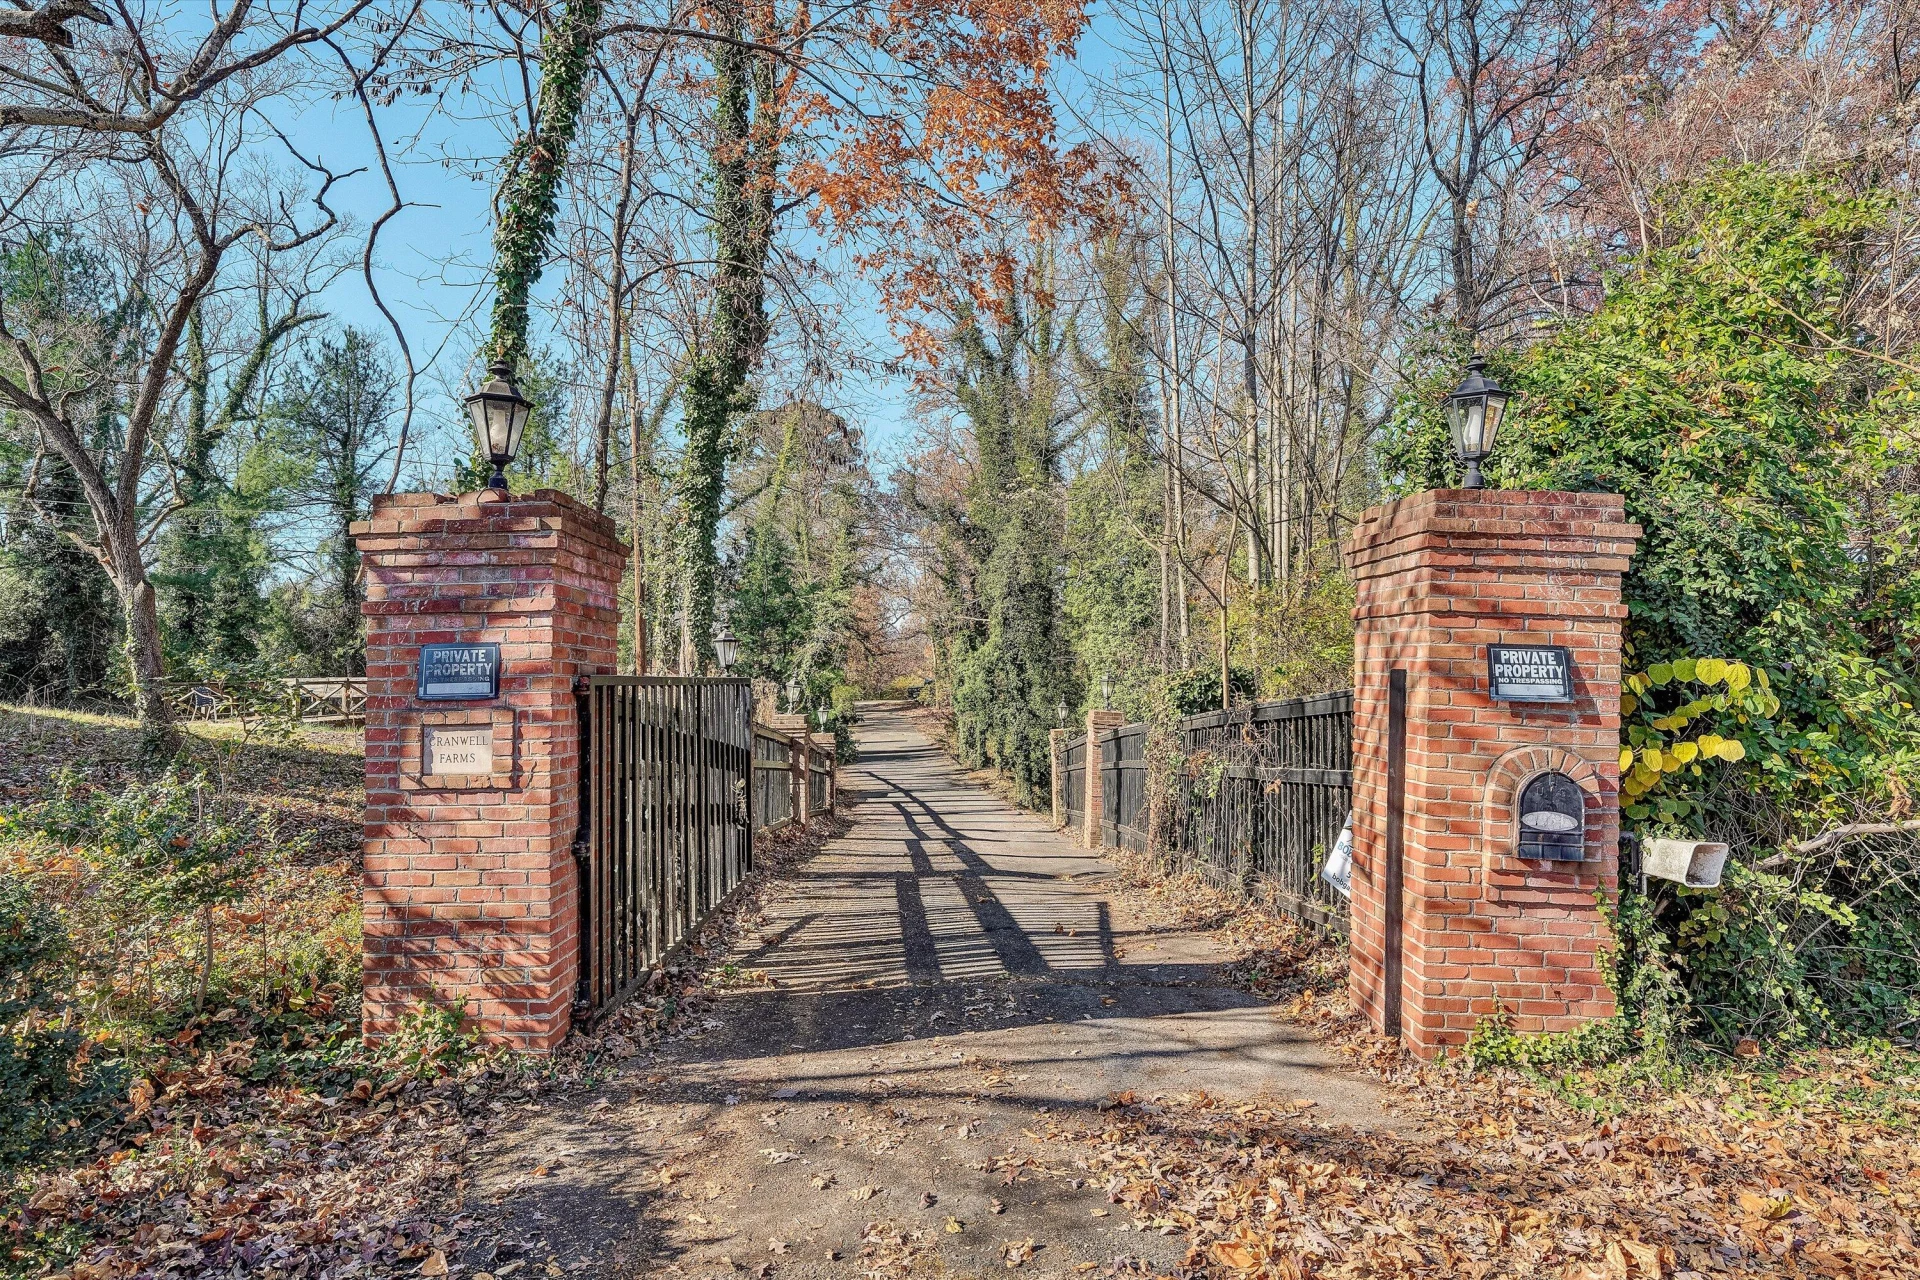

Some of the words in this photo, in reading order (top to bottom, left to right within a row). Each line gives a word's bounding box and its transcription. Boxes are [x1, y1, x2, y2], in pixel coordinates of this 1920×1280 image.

[432, 649, 486, 664] PRIVATE
[1500, 650, 1557, 665] PRIVATE
[425, 662, 493, 676] PROPERTY
[1494, 663, 1564, 679] PROPERTY
[1511, 677, 1563, 685] TRESPASSING
[428, 735, 489, 747] CRANWELL
[439, 753, 476, 764] FARMS
